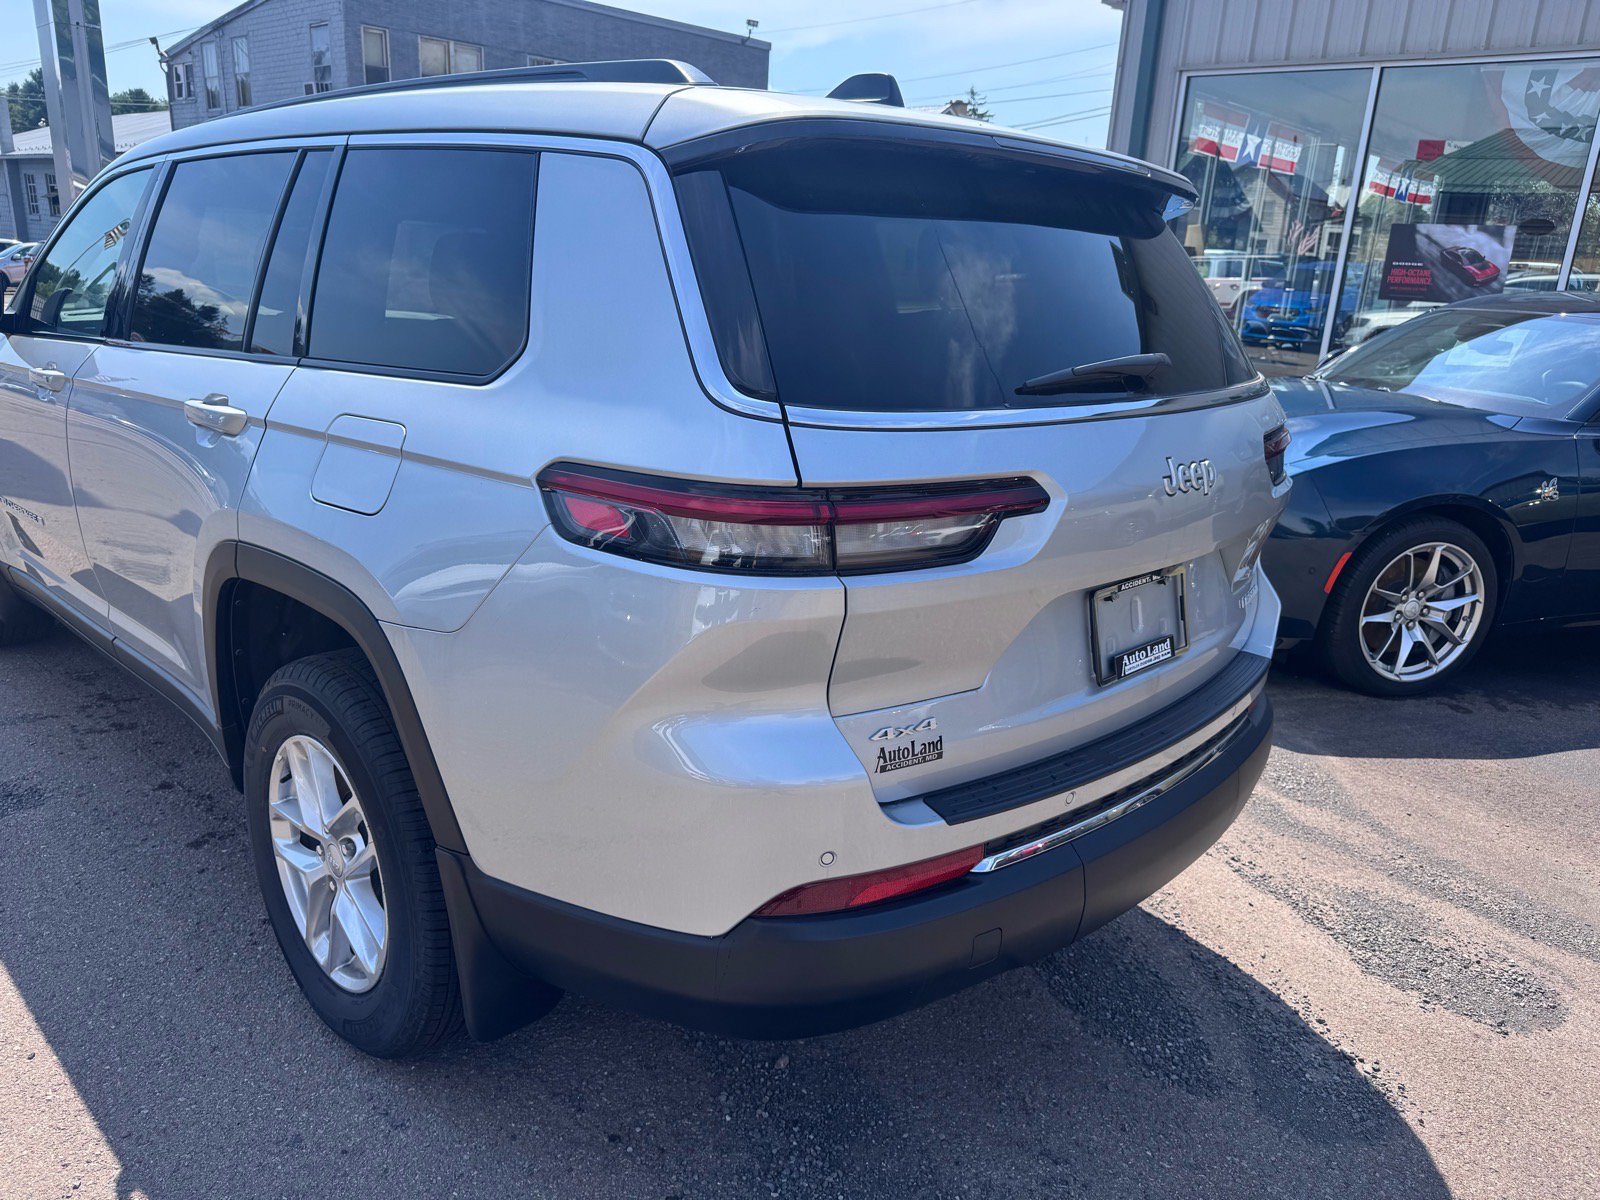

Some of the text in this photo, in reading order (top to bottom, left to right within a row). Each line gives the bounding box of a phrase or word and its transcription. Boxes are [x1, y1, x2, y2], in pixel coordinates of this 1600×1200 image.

[1162, 456, 1217, 497] Jeep
[1121, 638, 1171, 677] Auto Land
[874, 735, 944, 773] AutoLand
[925, 753, 938, 762] MD
